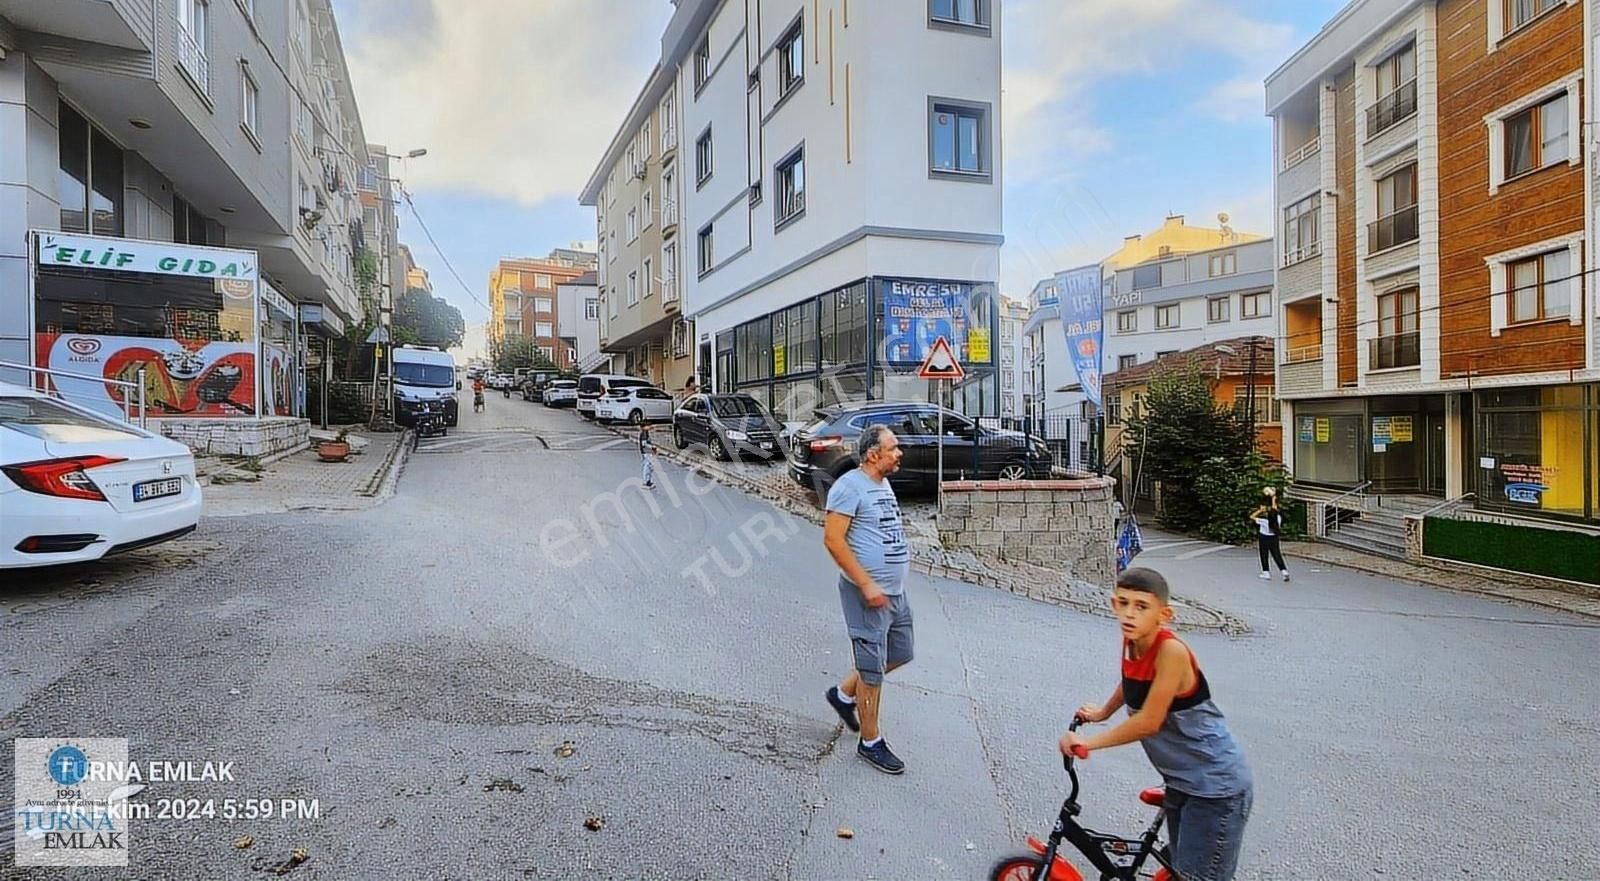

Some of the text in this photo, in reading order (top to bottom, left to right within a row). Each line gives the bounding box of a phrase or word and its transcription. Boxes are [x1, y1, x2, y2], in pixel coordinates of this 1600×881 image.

[55, 247, 238, 277] ELİF GIDA
[892, 281, 961, 297] EMRE SU
